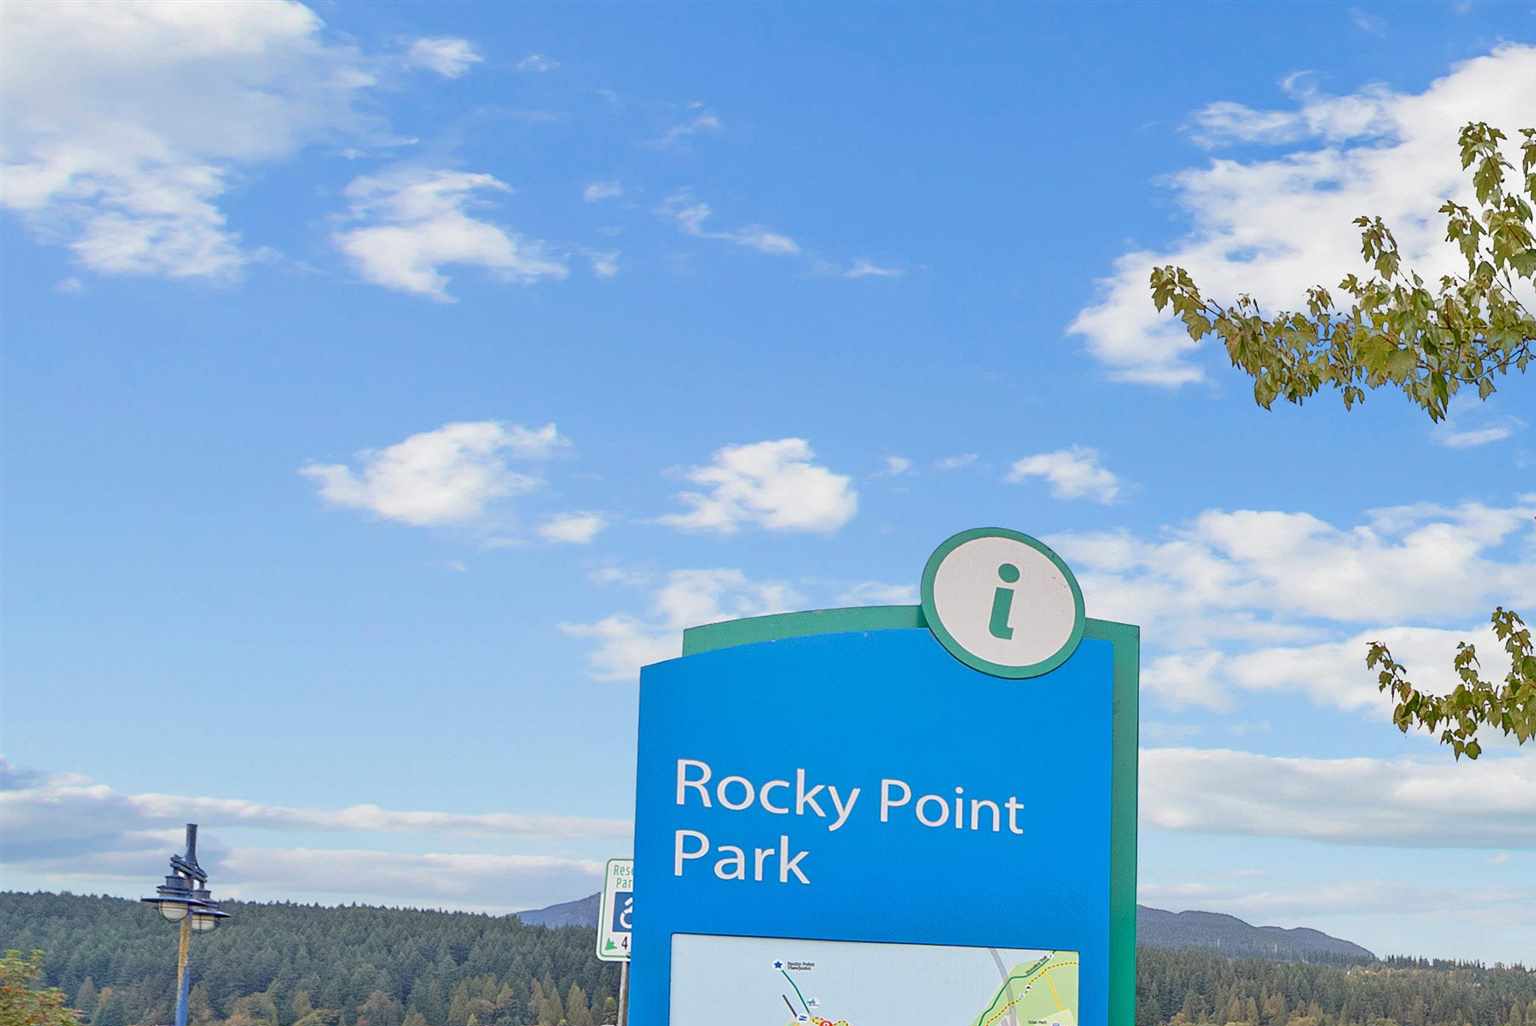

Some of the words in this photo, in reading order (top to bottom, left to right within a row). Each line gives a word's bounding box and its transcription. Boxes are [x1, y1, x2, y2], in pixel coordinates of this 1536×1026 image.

[675, 758, 861, 831] Rocky
[879, 777, 1025, 835] Point
[613, 864, 633, 876] Res
[673, 828, 811, 885] Park
